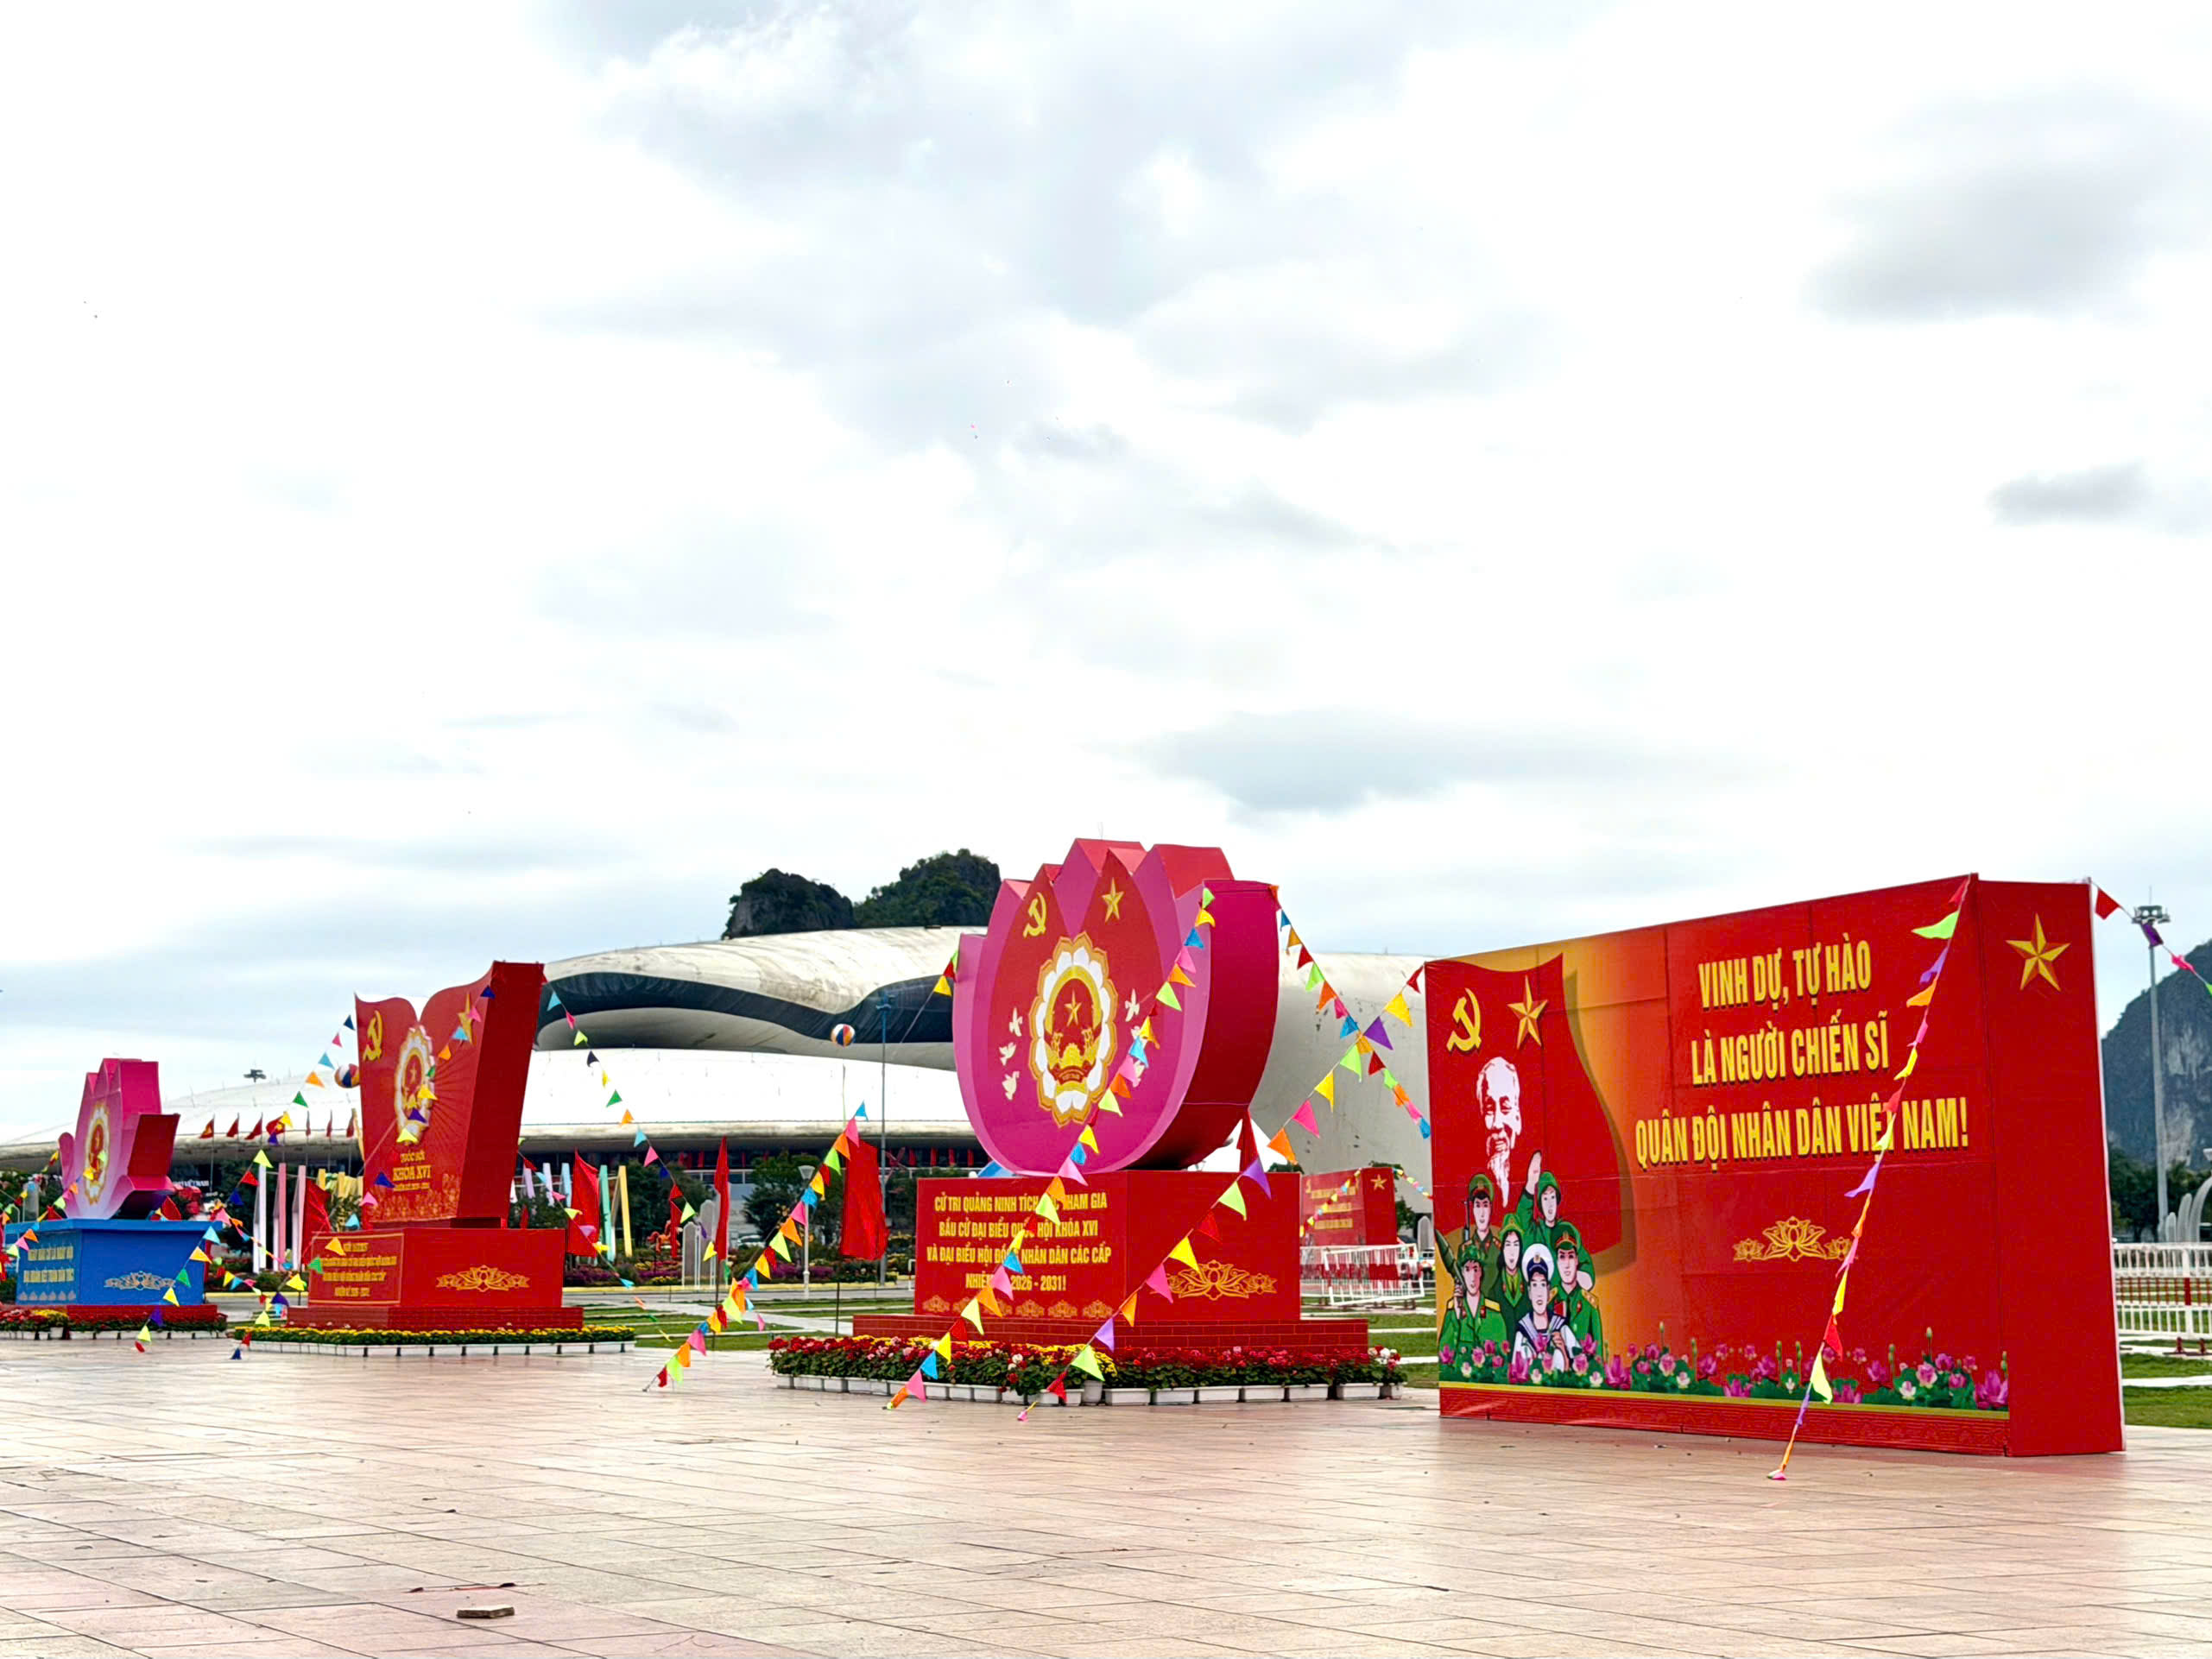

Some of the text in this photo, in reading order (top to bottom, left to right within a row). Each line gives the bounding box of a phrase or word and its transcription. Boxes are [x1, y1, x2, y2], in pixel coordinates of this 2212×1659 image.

[1698, 931, 1872, 1011] VINH DỰ, TỰ HÀO
[1691, 1008, 1890, 1085] LÀ NGƯỜI CHIẾN SĨ
[1635, 1108, 1689, 1170] QUÂN
[1692, 1105, 1728, 1171] ĐỘI
[1731, 1101, 1792, 1159] NHÂN
[1795, 1096, 1843, 1155] DÂN
[1901, 1096, 1969, 1151] NAM!
[934, 1191, 947, 1212] CỬ
[948, 1196, 962, 1212] TRI
[963, 1191, 993, 1214] QUẢNG
[994, 1196, 1017, 1212] NINH
[1019, 1193, 1039, 1212] TÍCH
[1090, 1192, 1108, 1209] GIA
[971, 1222, 987, 1241] ĐẠI
[988, 1216, 1009, 1238] BIỂU
[1082, 1220, 1099, 1237] XVI
[926, 1243, 939, 1261] VÀ
[939, 1246, 955, 1266] ĐẠI
[956, 1242, 976, 1263] BIỂU
[977, 1245, 993, 1267] HỘI
[1021, 1245, 1047, 1265] NHÂN
[1048, 1245, 1069, 1265] DÂN
[1070, 1244, 1090, 1264] CÁC
[1010, 1275, 1033, 1291] 2026
[1040, 1275, 1067, 1291] 2031!
